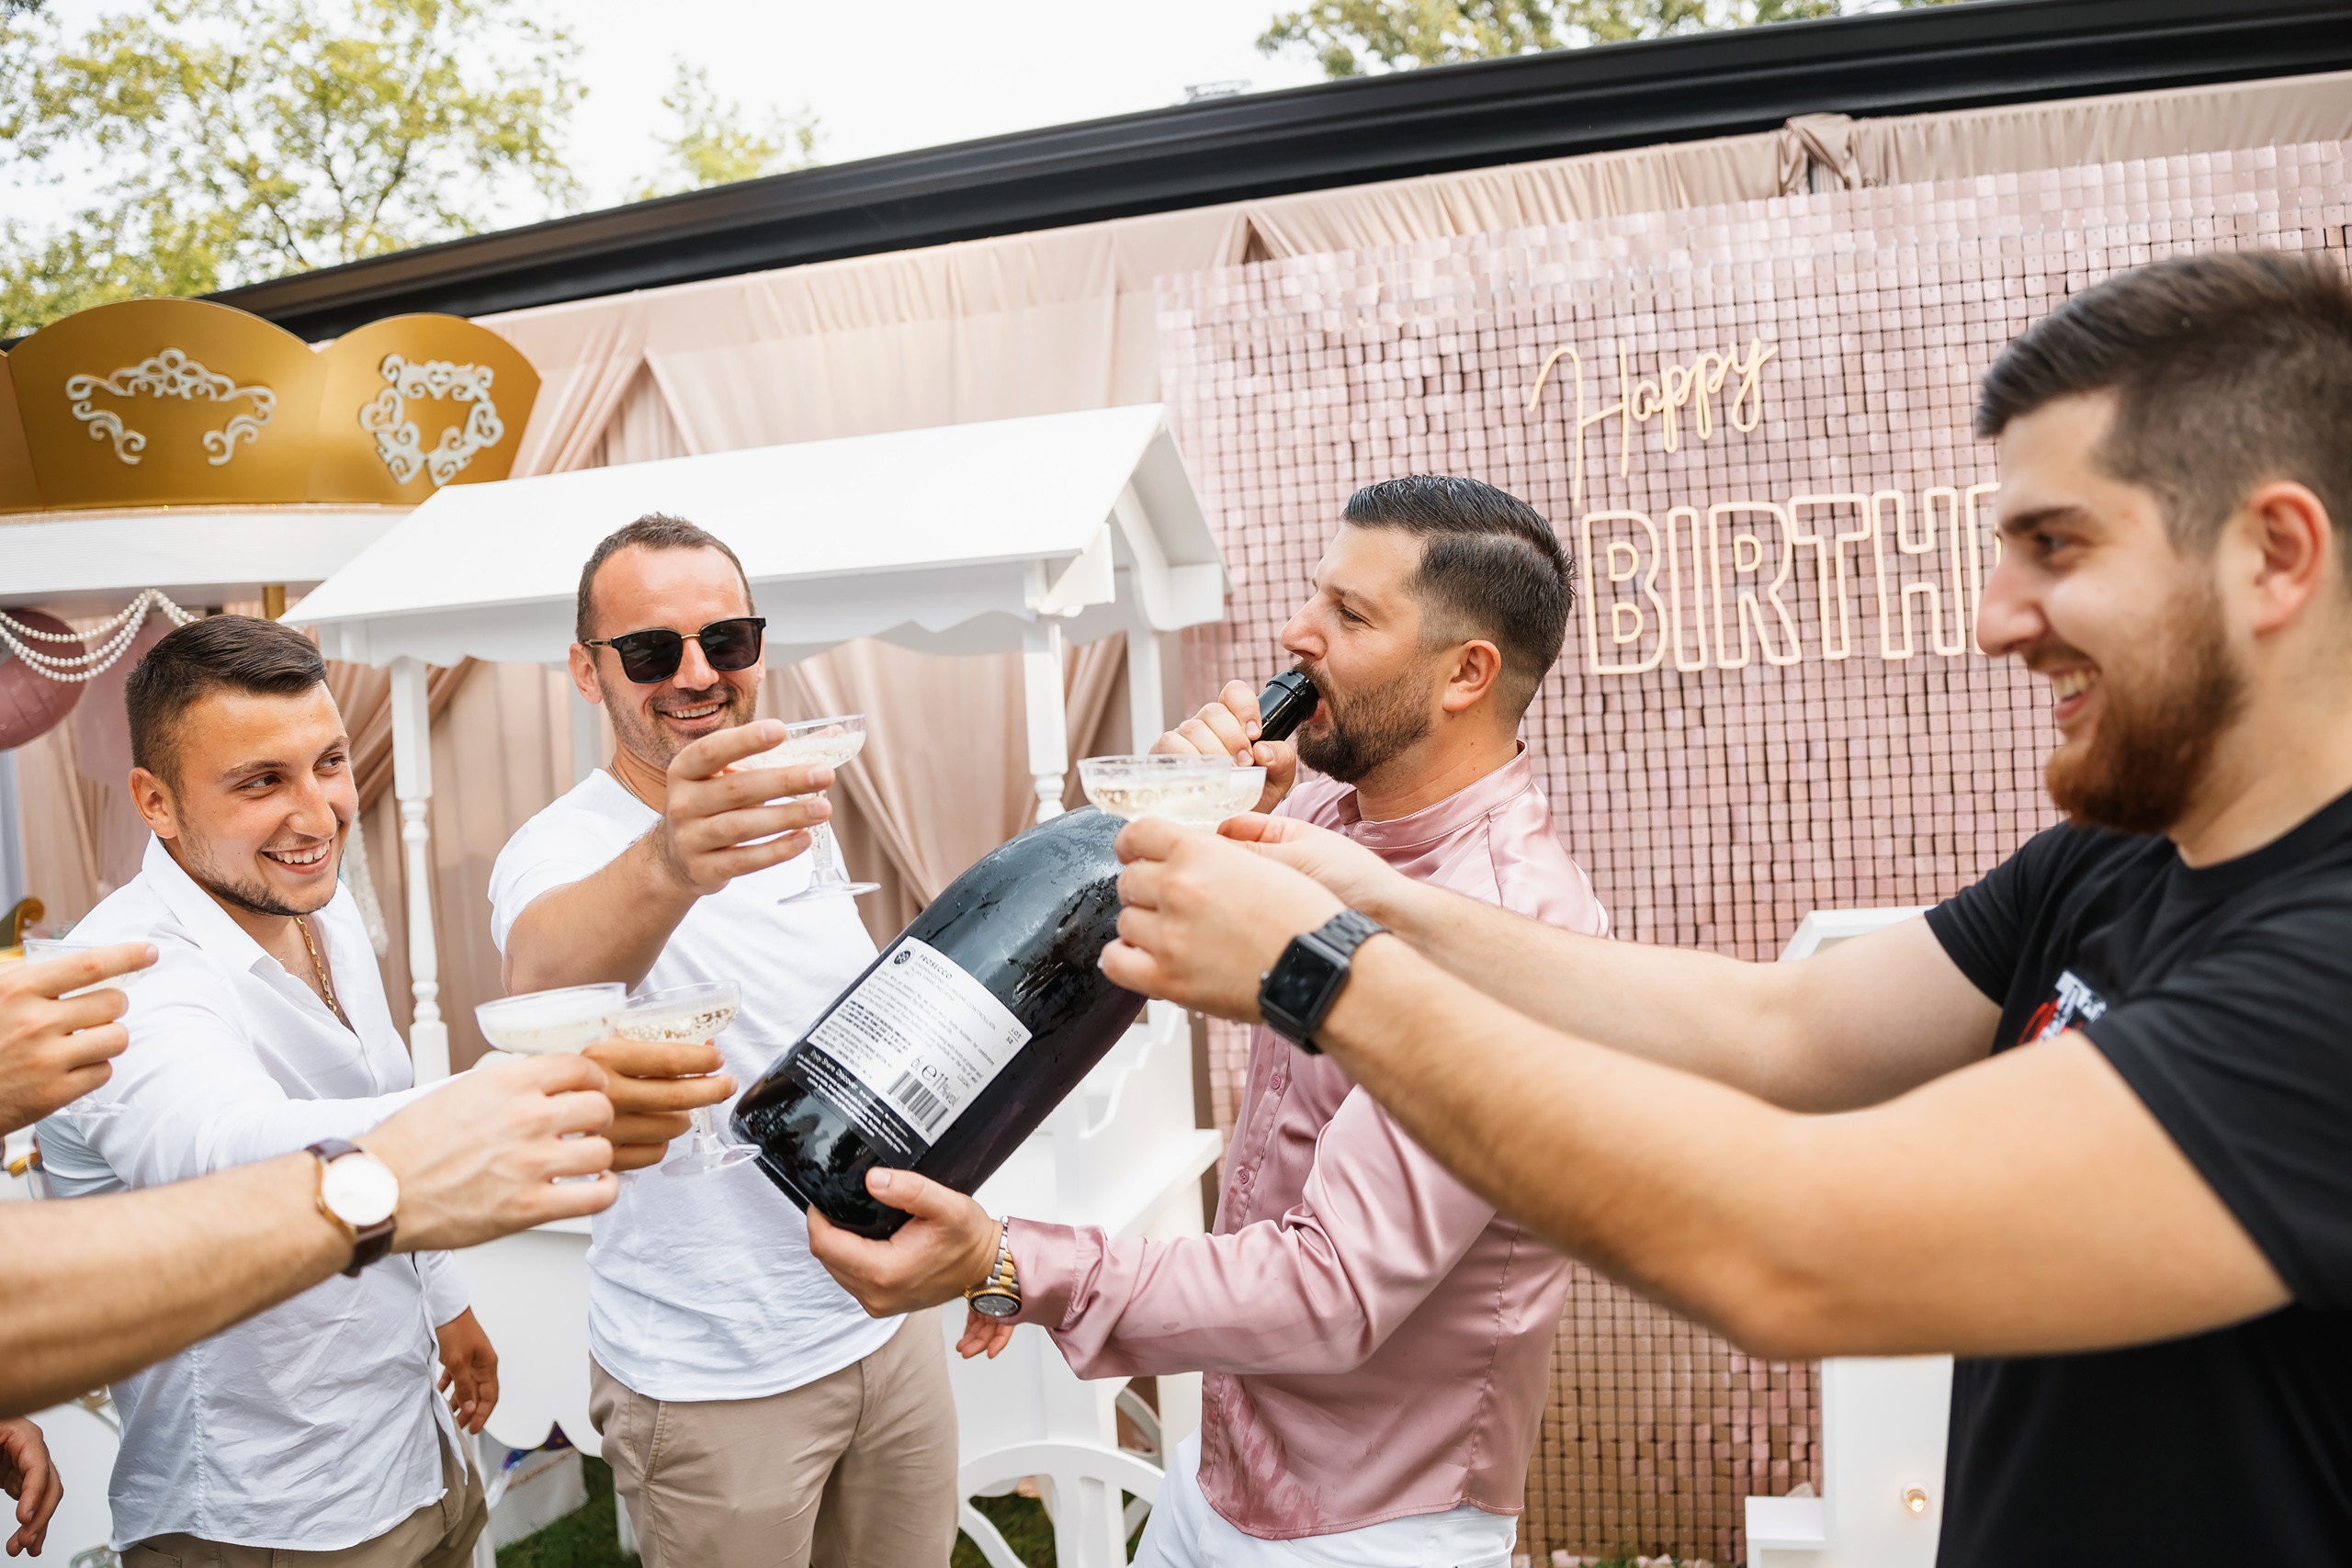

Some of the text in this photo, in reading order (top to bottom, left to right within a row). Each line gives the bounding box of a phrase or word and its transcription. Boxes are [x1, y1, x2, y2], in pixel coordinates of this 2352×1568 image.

[1527, 337, 1779, 507] Happy
[920, 954, 953, 979] PROSECCO
[1012, 1028, 1022, 1039] LOT
